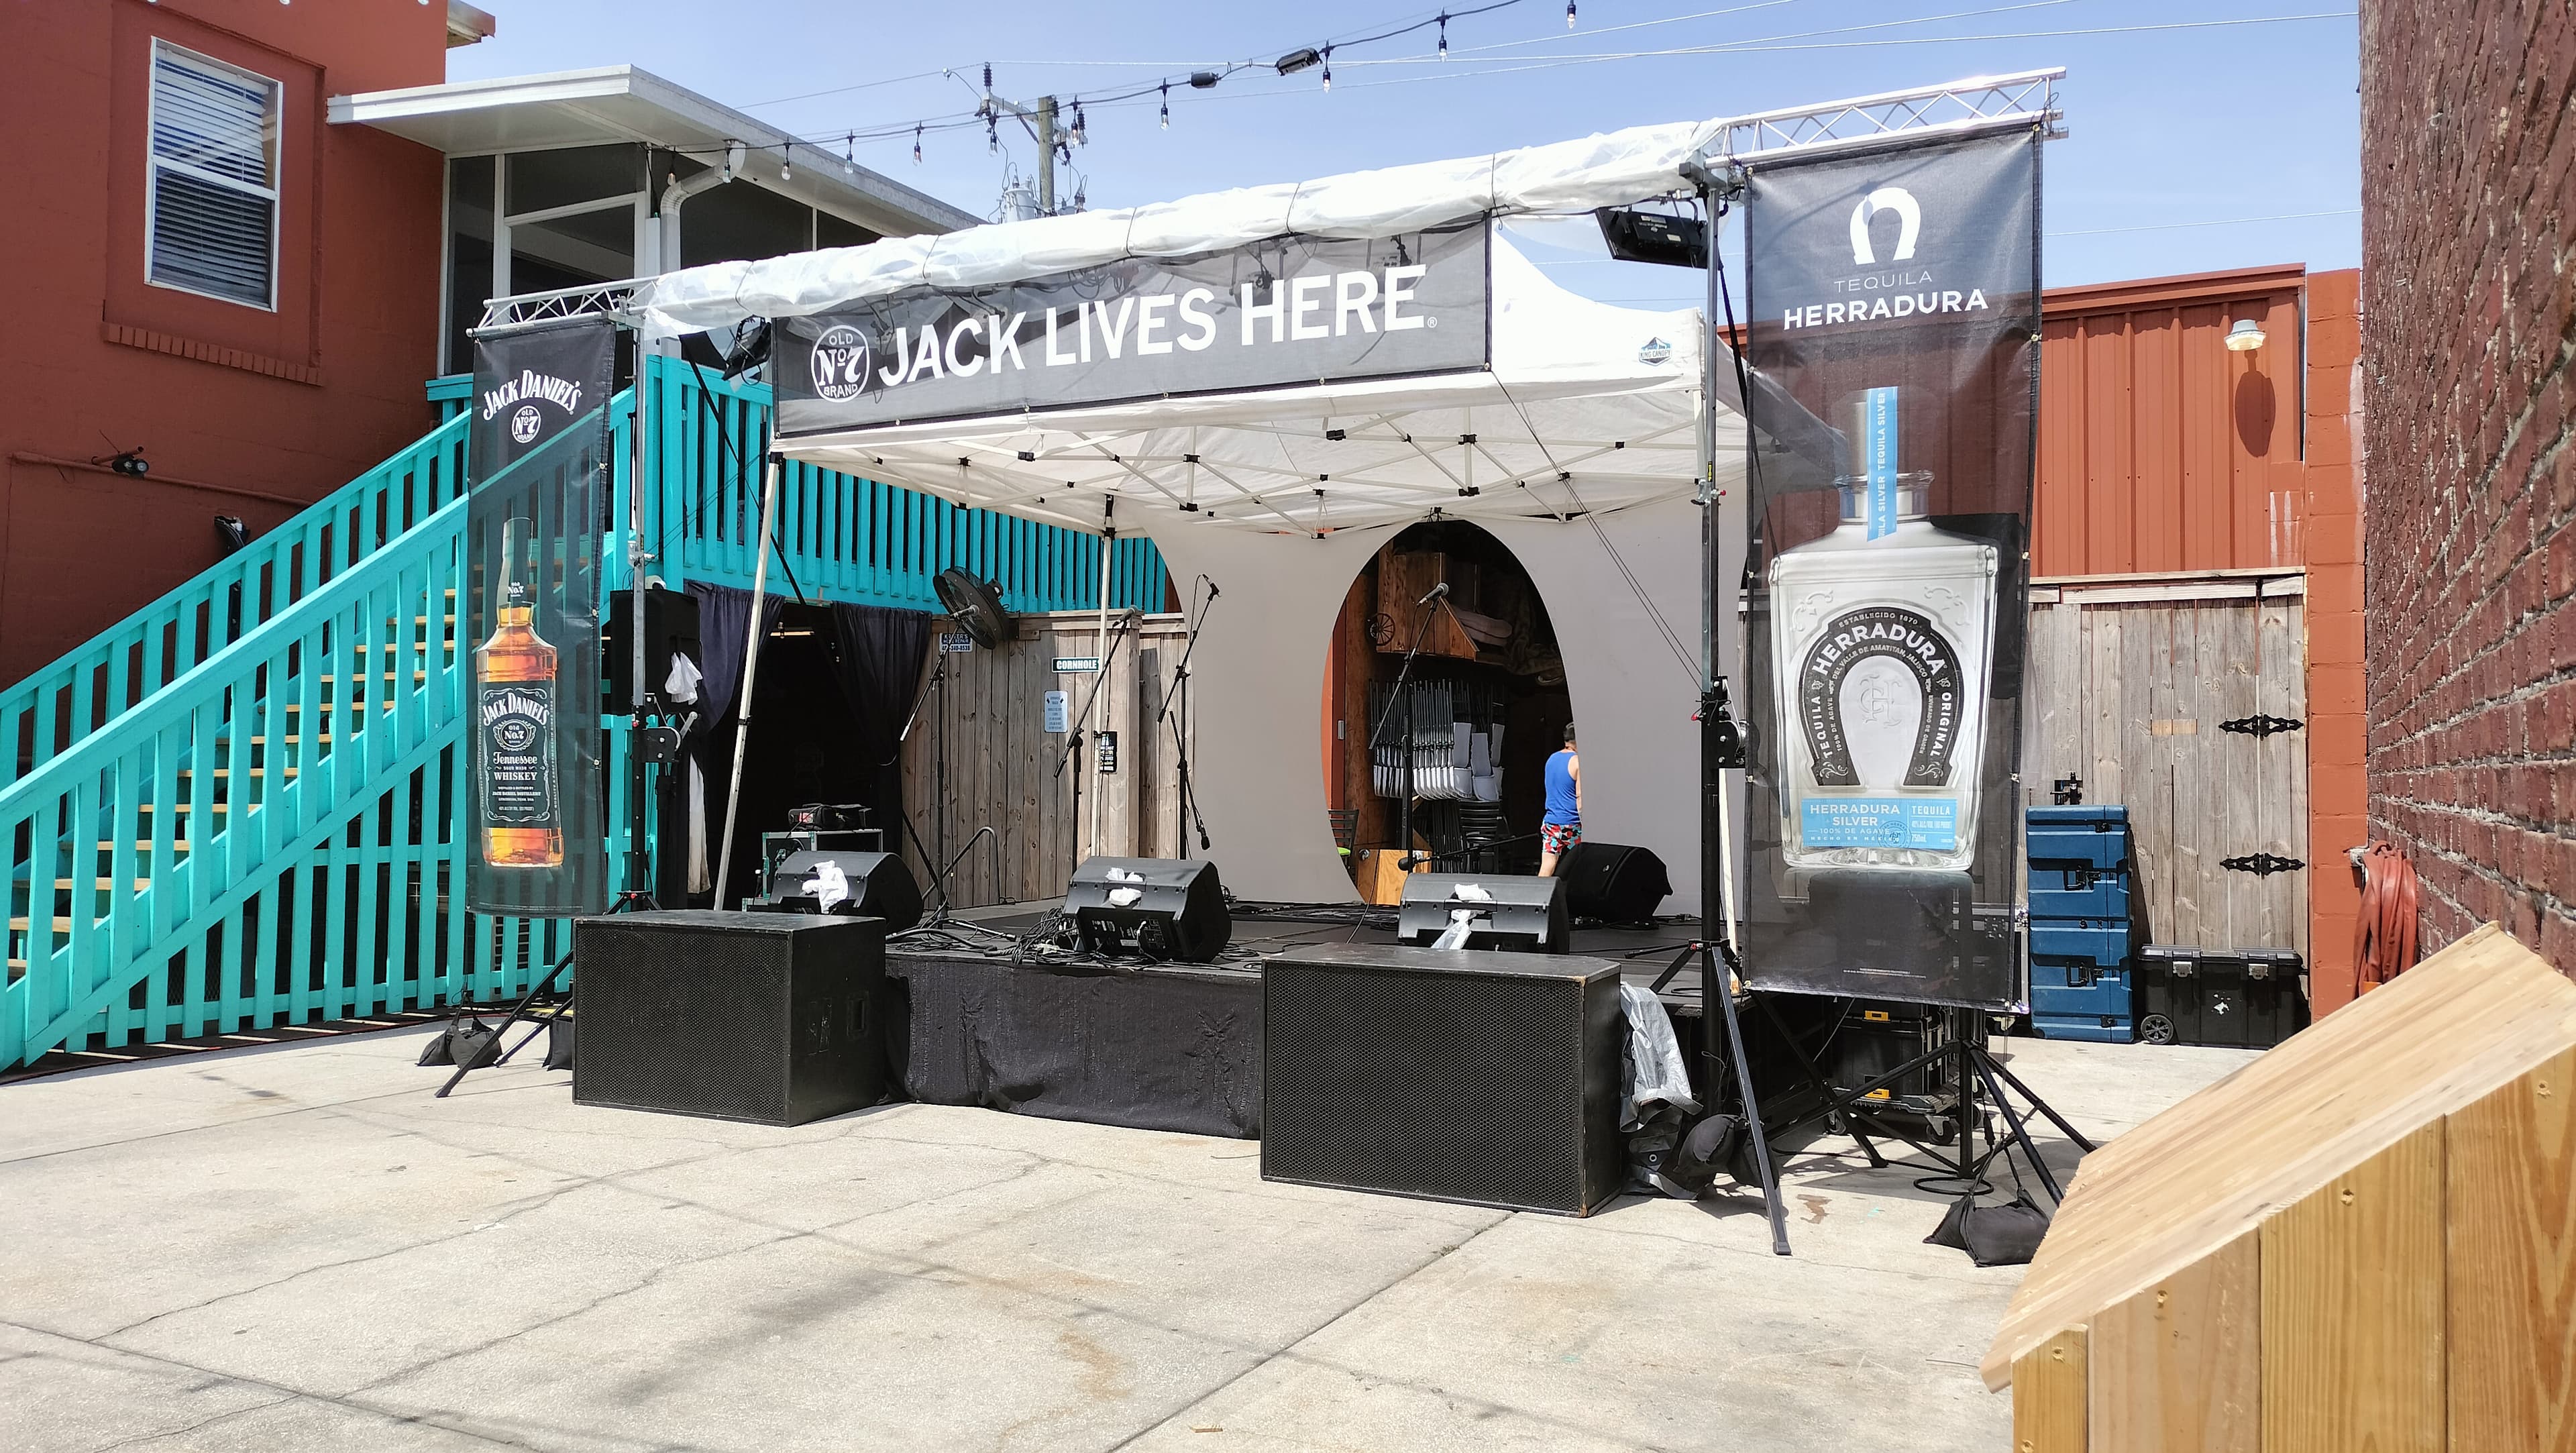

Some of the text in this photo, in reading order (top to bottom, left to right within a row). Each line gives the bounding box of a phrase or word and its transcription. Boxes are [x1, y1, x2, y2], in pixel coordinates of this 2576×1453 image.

[1834, 270, 1933, 293] TEQUILA
[1784, 288, 1989, 330] HERRADURA
[828, 331, 853, 345] OLD
[879, 319, 1025, 386] JACK
[1045, 287, 1217, 367] LIVES
[1640, 348, 1671, 359] KING CANOPY
[483, 369, 582, 421] JACK DANIEL'S
[823, 383, 859, 399] BRAND
[1877, 392, 1886, 470] TEQUILA SILVER
[1878, 475, 1886, 513] SILVER
[1838, 612, 1919, 628] ESTABLECIDO 1870
[1811, 623, 1946, 677] HERRADURA
[1057, 659, 1097, 669] CORNHOLE
[1832, 667, 1843, 680] DEL
[1839, 650, 1858, 666] VALLE
[1858, 645, 1869, 654] DE
[1906, 653, 1928, 678] JALISCO
[483, 698, 508, 726] JACK
[507, 692, 549, 725] DANIEL'S
[1827, 697, 1835, 720] AGAVE
[1811, 696, 1833, 759] TEQUILA
[1830, 722, 1837, 733] DE
[1930, 692, 1952, 757] ORIGINAL
[493, 751, 537, 764] Tennessee
[494, 772, 537, 781] WHISKEY
[1810, 804, 1900, 814] HERRADURA
[1911, 806, 1950, 815] TEQUILA
[1833, 816, 1878, 826] SILVER
